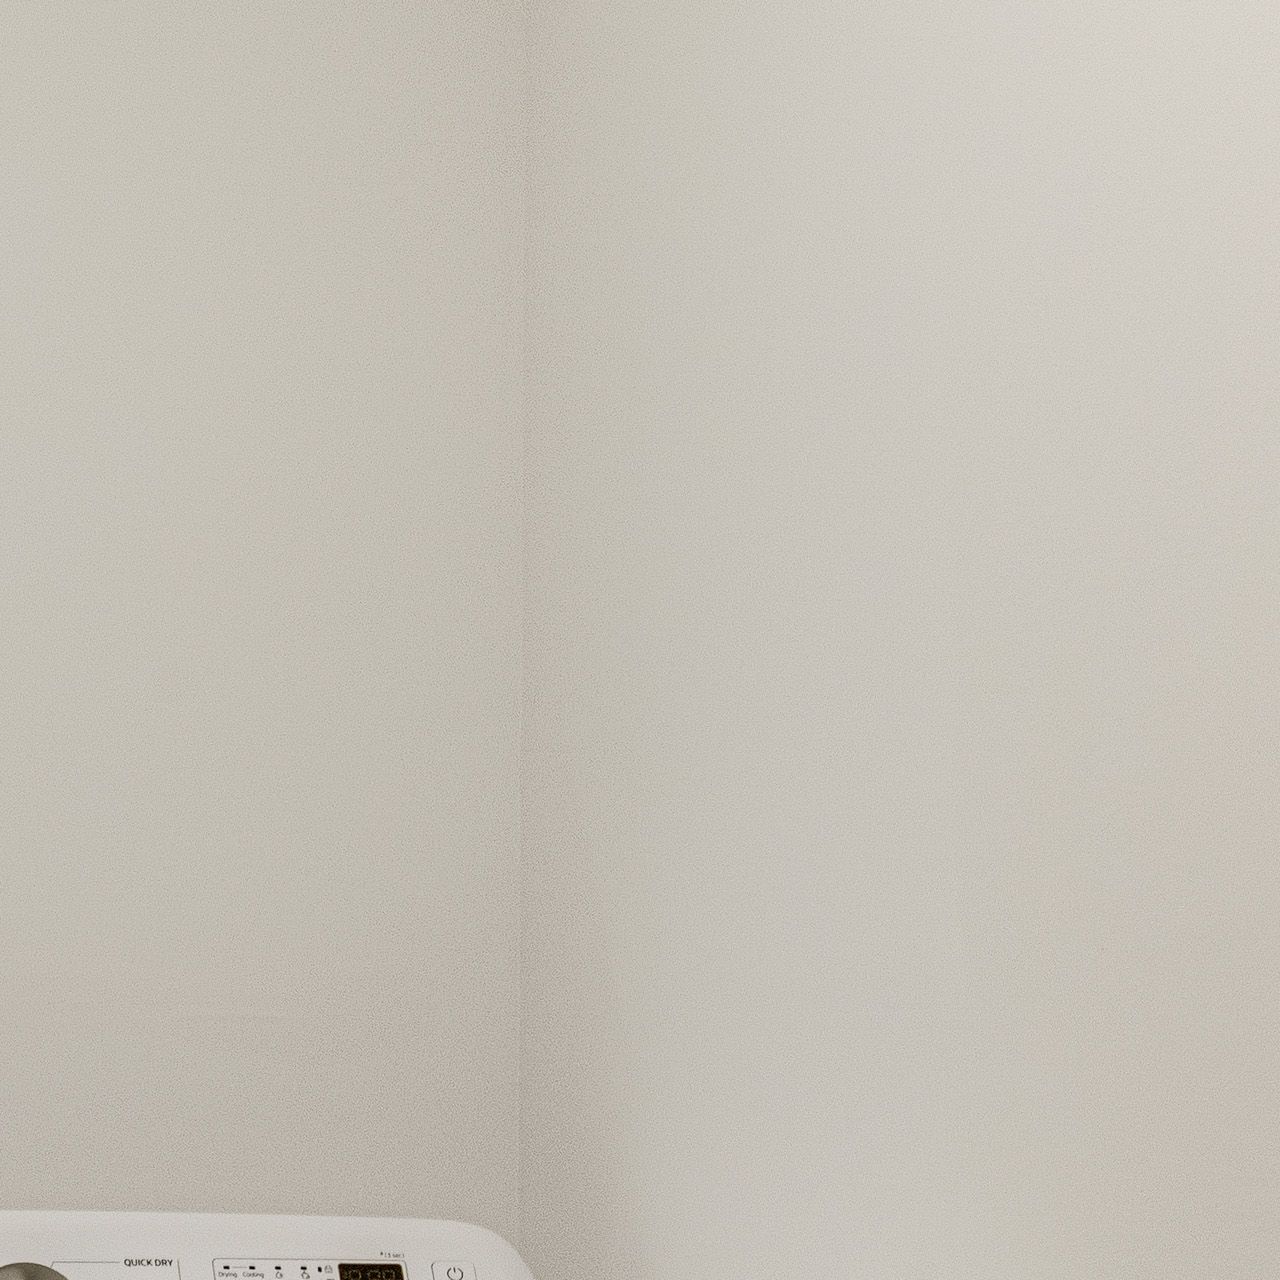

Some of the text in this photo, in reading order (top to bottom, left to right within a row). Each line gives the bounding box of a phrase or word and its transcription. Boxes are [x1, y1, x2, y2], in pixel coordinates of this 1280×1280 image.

[123, 1258, 173, 1267] QUICK DRY
[218, 1271, 238, 1279] Drying
